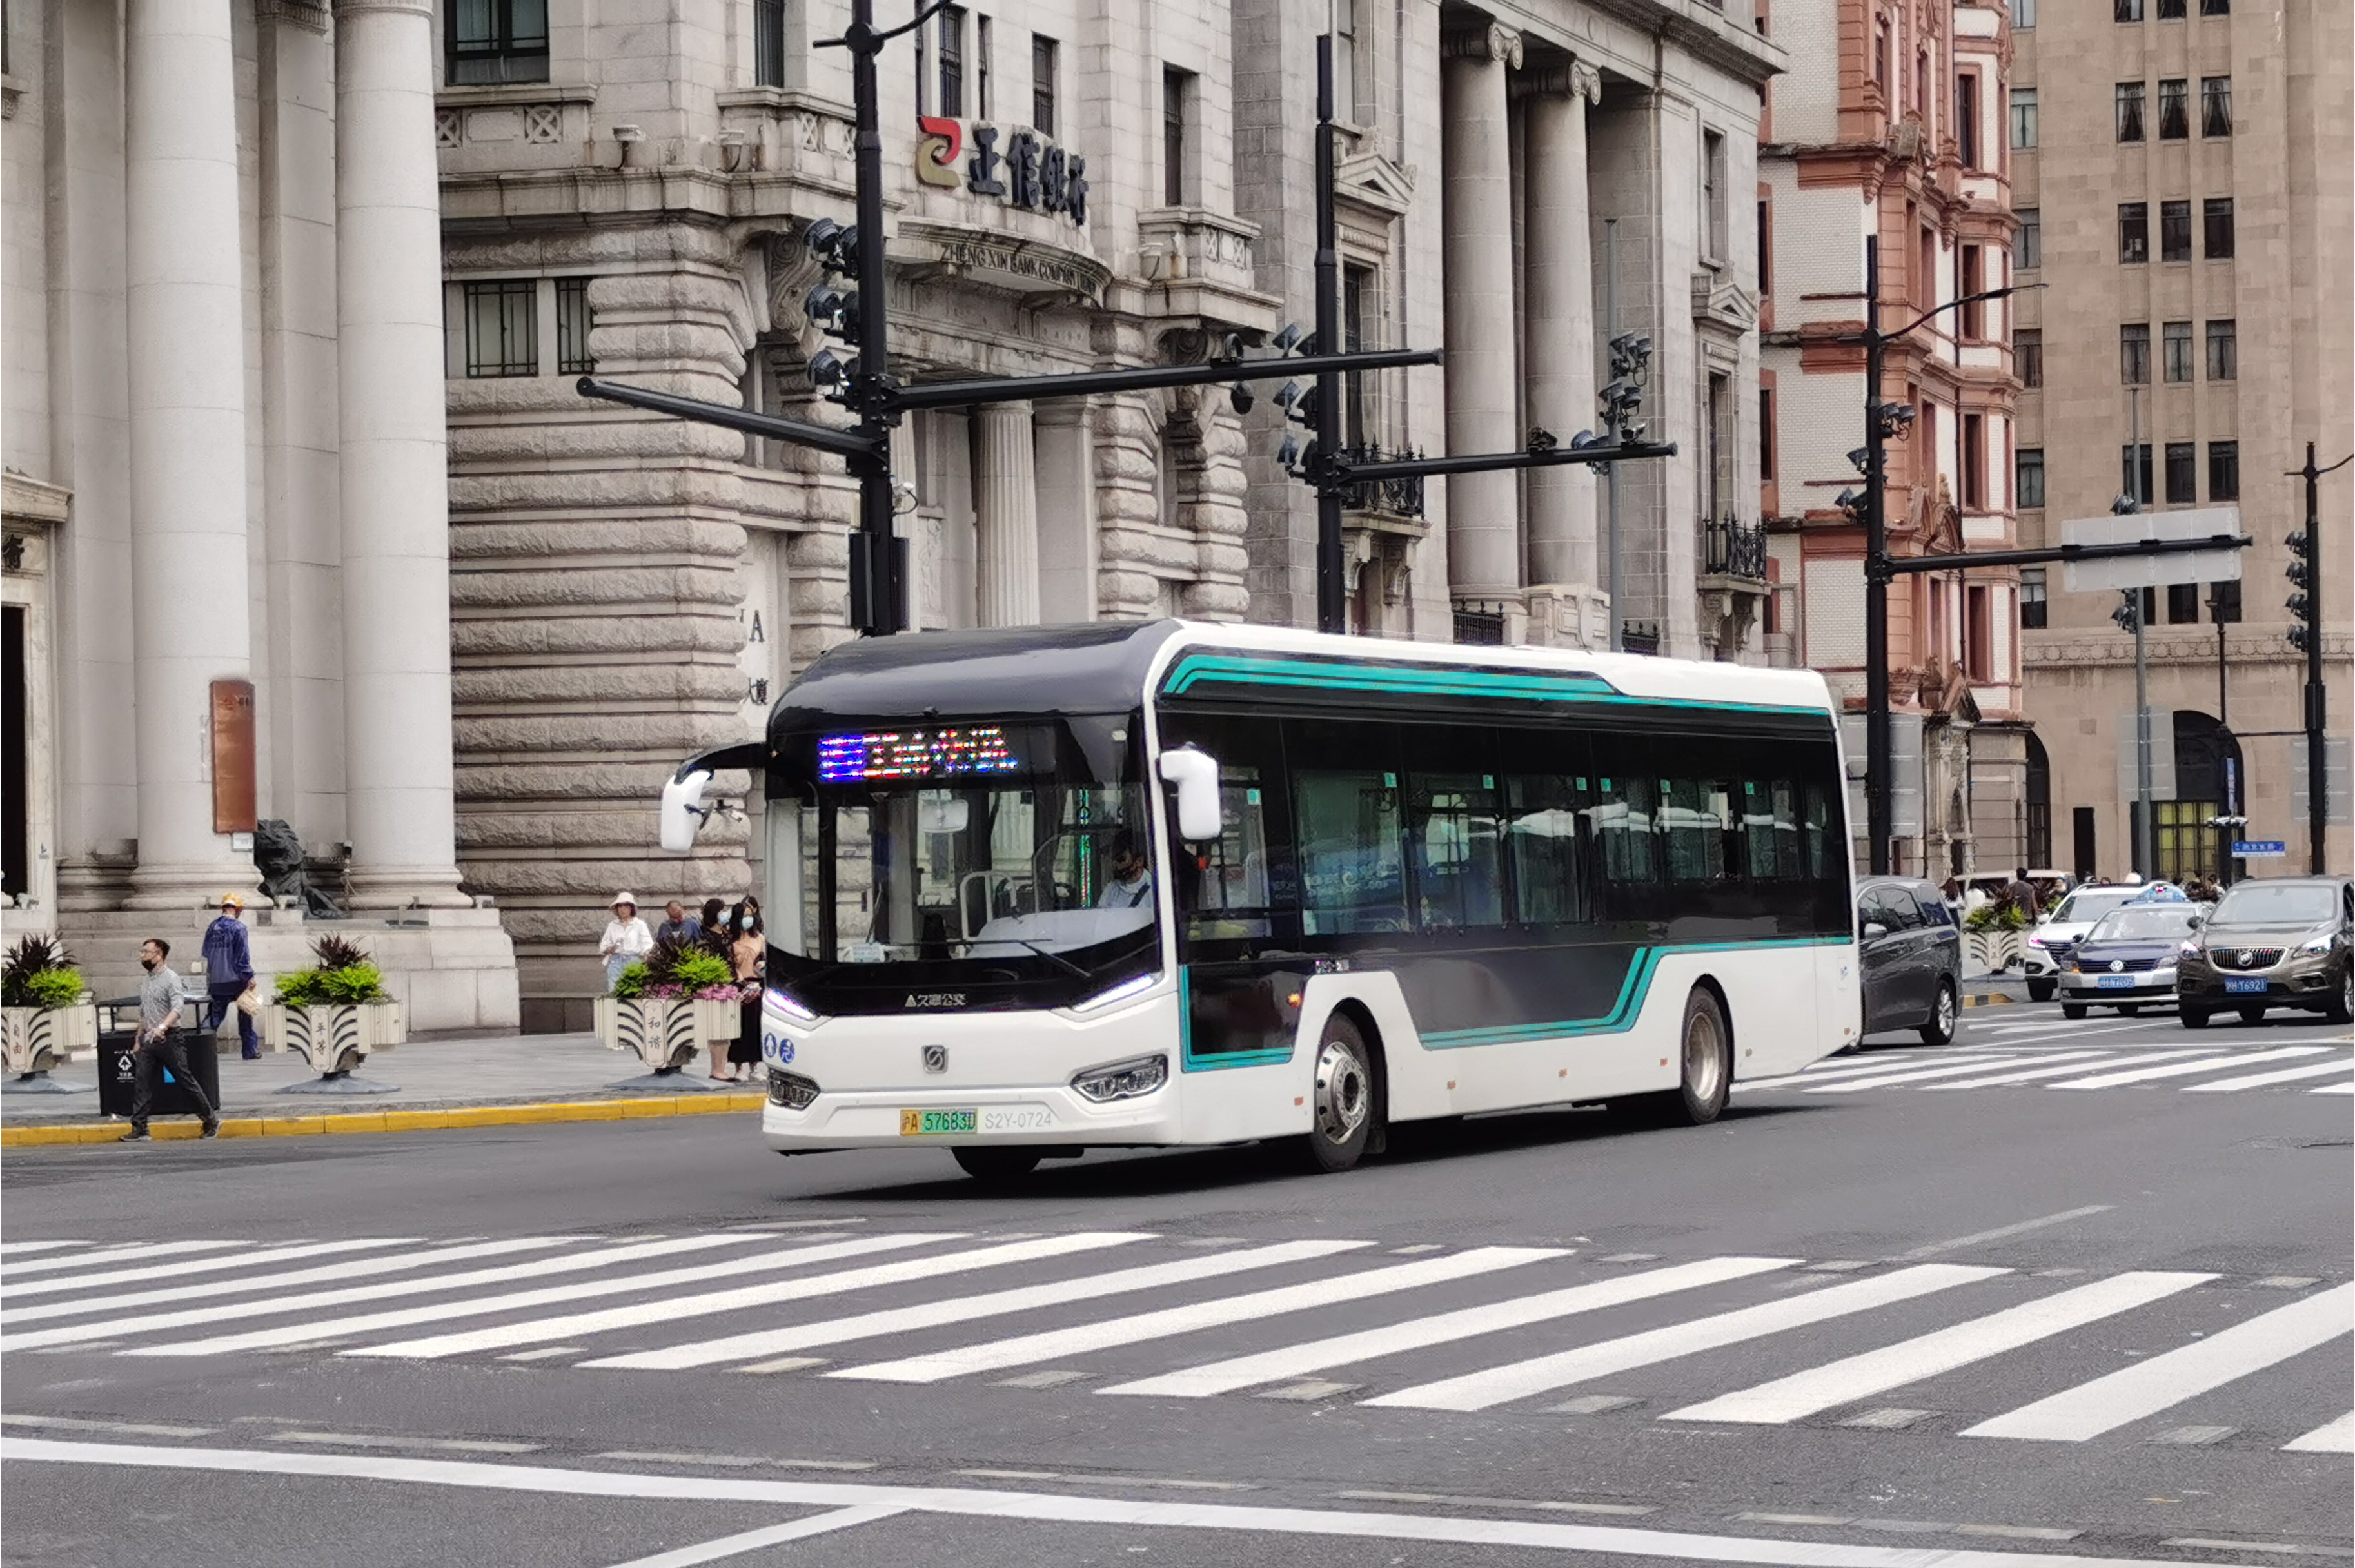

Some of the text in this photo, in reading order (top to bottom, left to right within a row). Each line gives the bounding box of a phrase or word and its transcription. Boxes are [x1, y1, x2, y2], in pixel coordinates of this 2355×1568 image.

[940, 243, 986, 268] ZHENG
[989, 249, 1008, 270] XIN
[985, 1113, 1052, 1129] S2Y-0724
